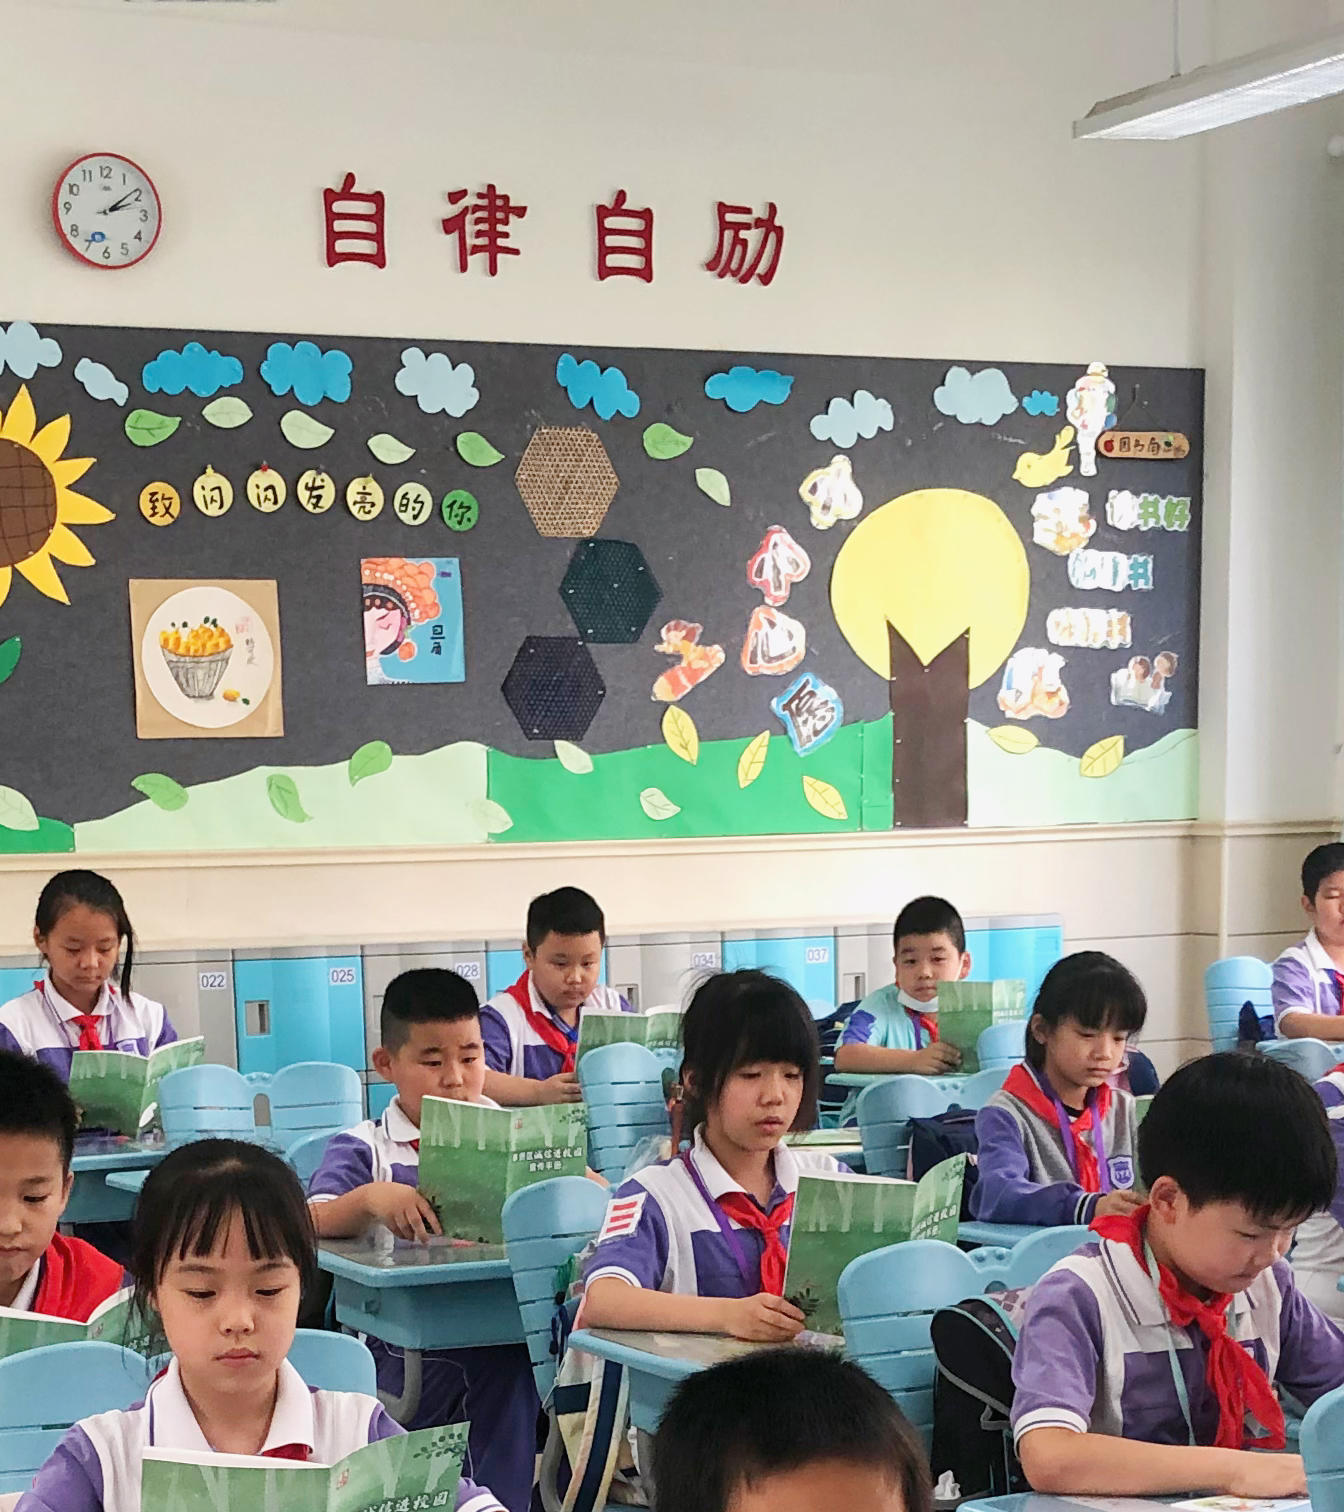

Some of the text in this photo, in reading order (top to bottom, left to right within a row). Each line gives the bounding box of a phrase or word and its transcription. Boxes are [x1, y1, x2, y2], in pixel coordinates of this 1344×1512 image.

[82, 169, 92, 182] 11
[99, 165, 112, 179] 12
[68, 183, 80, 196] 10
[134, 188, 143, 202] 2
[63, 201, 72, 215] 9
[139, 209, 148, 222] 3
[70, 224, 79, 237] 8
[133, 229, 142, 242] 4
[84, 239, 93, 252] 7
[102, 246, 111, 259] 6
[120, 242, 129, 255] 5
[148, 473, 471, 524] 致闪闪发亮的你
[693, 953, 715, 967] 034
[807, 948, 828, 963] 037
[331, 968, 355, 984] 025
[457, 963, 479, 978] 028
[201, 973, 225, 989] 022
